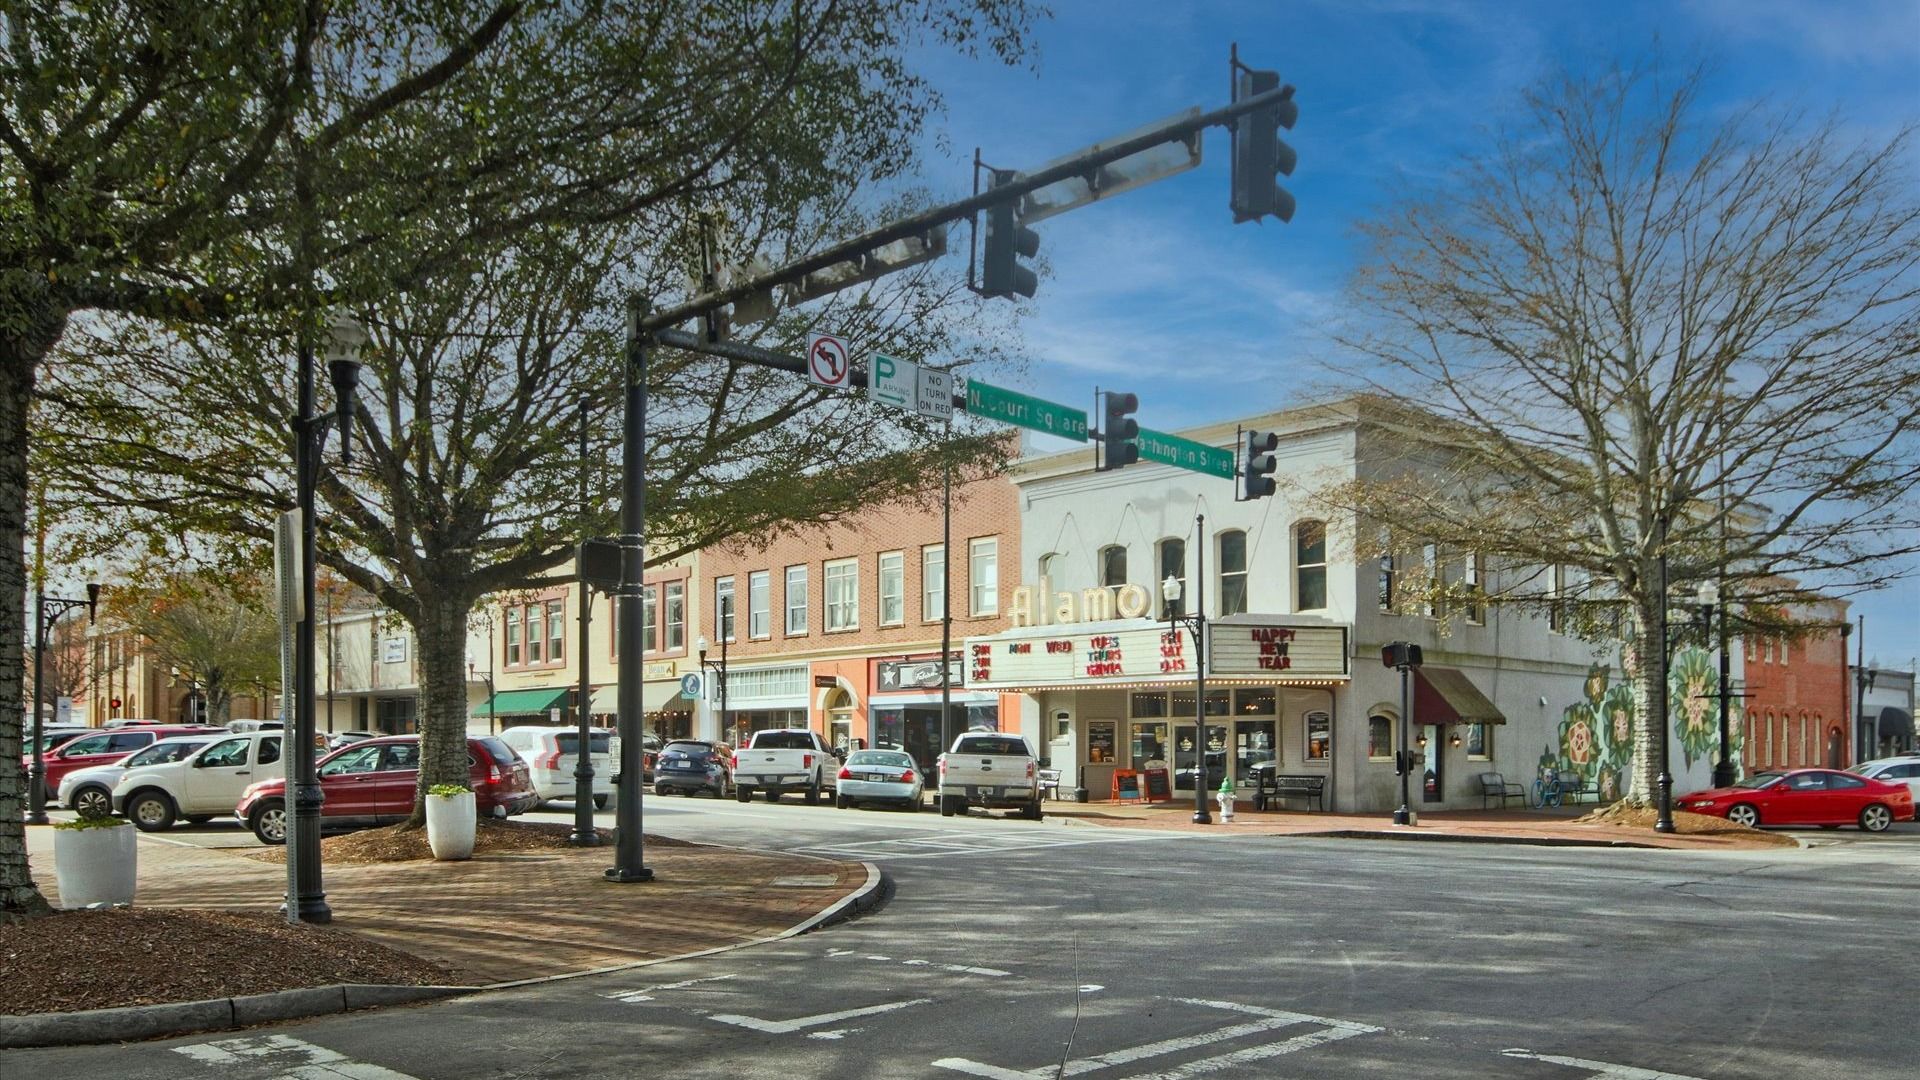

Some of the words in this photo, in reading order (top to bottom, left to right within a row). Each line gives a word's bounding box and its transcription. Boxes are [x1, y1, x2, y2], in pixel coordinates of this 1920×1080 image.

[928, 375, 942, 386] NO
[925, 387, 946, 400] TURN
[920, 400, 931, 410] ON
[935, 403, 951, 414] RED
[971, 390, 984, 409] N.
[989, 395, 1028, 419] Court
[1132, 434, 1196, 463] ahington
[1200, 451, 1232, 473] Street
[1252, 629, 1296, 641] HAPPY
[1009, 644, 1031, 654] MON
[1046, 641, 1072, 653] WED
[1091, 636, 1120, 649] TUES
[1261, 643, 1288, 656] NEW
[1087, 649, 1122, 661] THURS
[1160, 645, 1182, 657] SAT
[1258, 656, 1290, 670] YEAR
